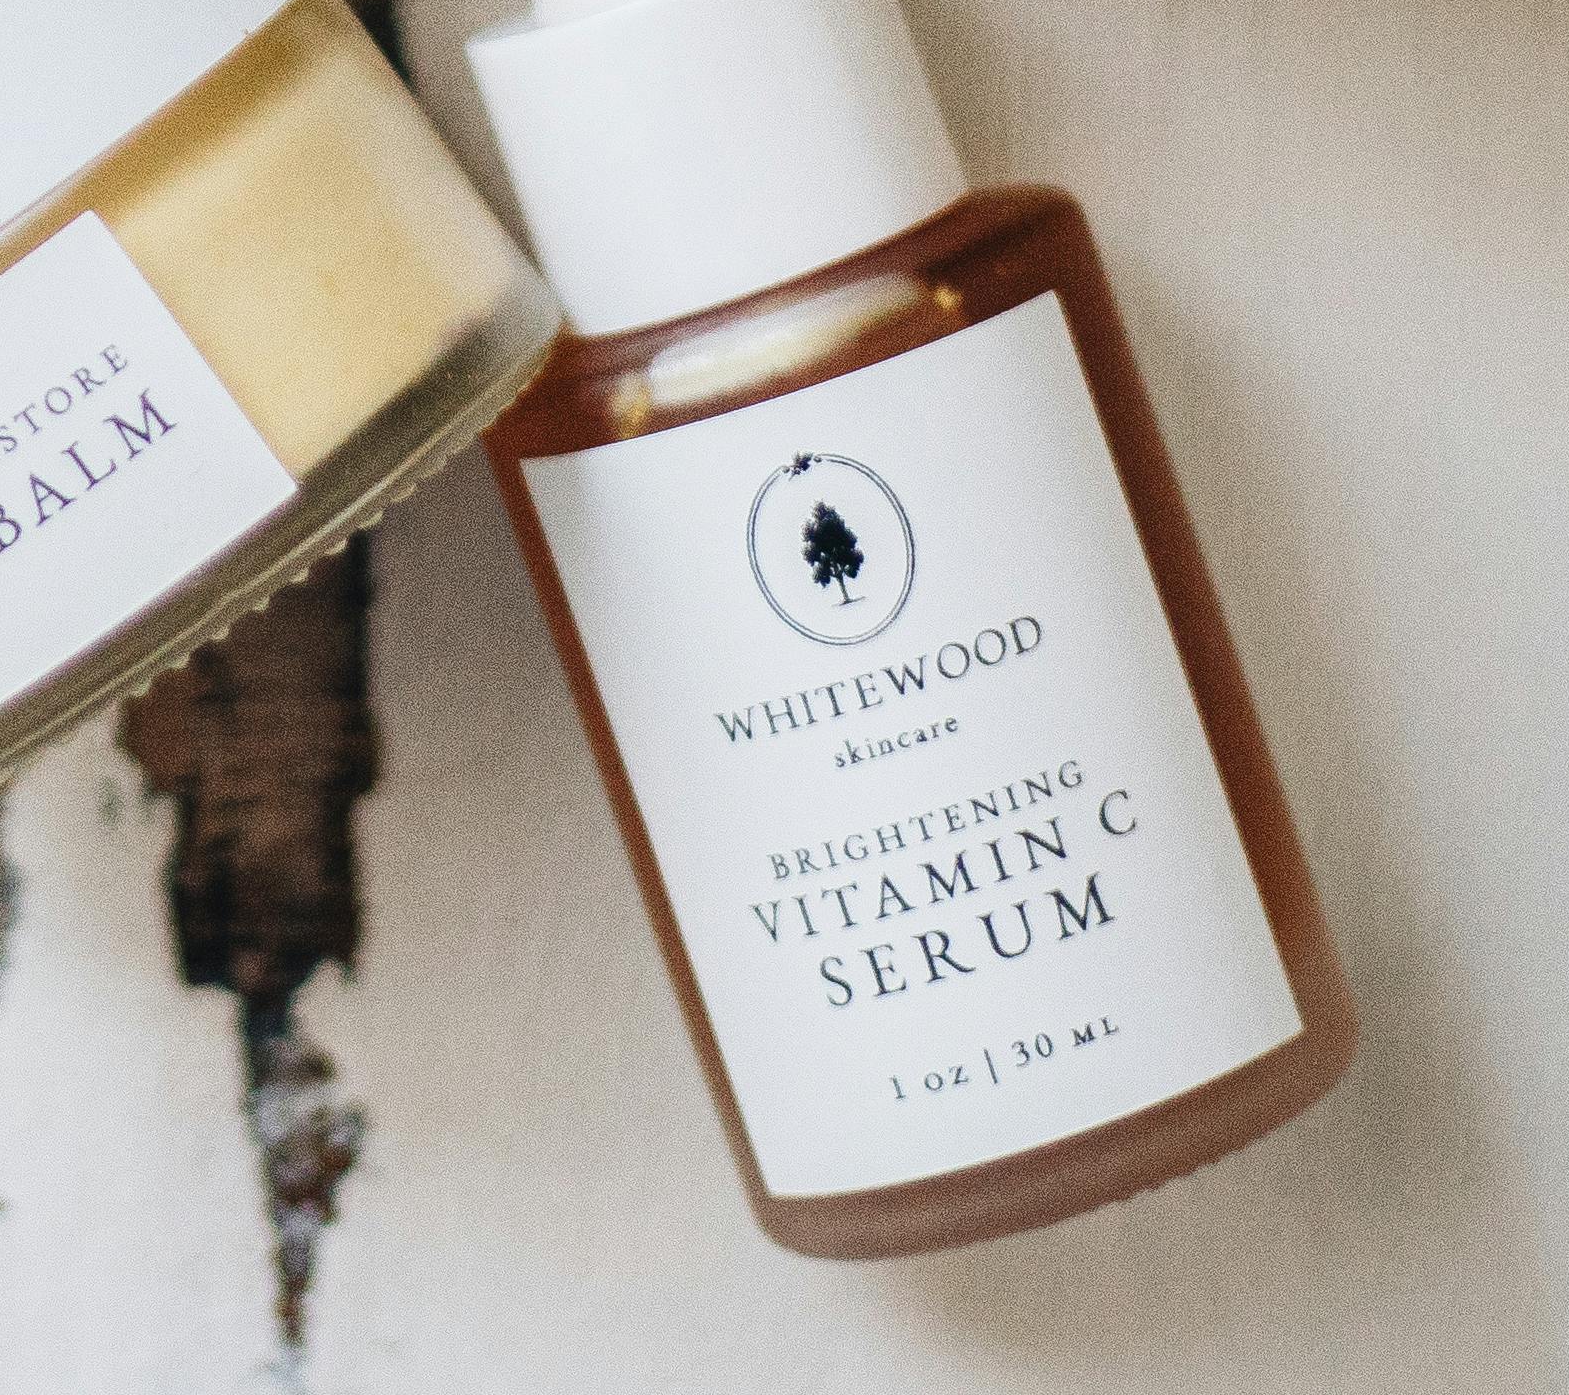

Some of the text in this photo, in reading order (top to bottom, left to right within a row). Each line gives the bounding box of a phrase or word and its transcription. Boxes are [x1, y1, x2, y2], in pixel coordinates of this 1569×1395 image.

[716, 615, 1044, 743] WHITEWOOD
[834, 716, 960, 768] skincare
[750, 789, 1137, 943] VITAMIN C
[769, 760, 1084, 881] BRIGHTENING
[819, 872, 1116, 1007] SERUM
[890, 1075, 906, 1100] 1
[1011, 1032, 1053, 1066] 30
